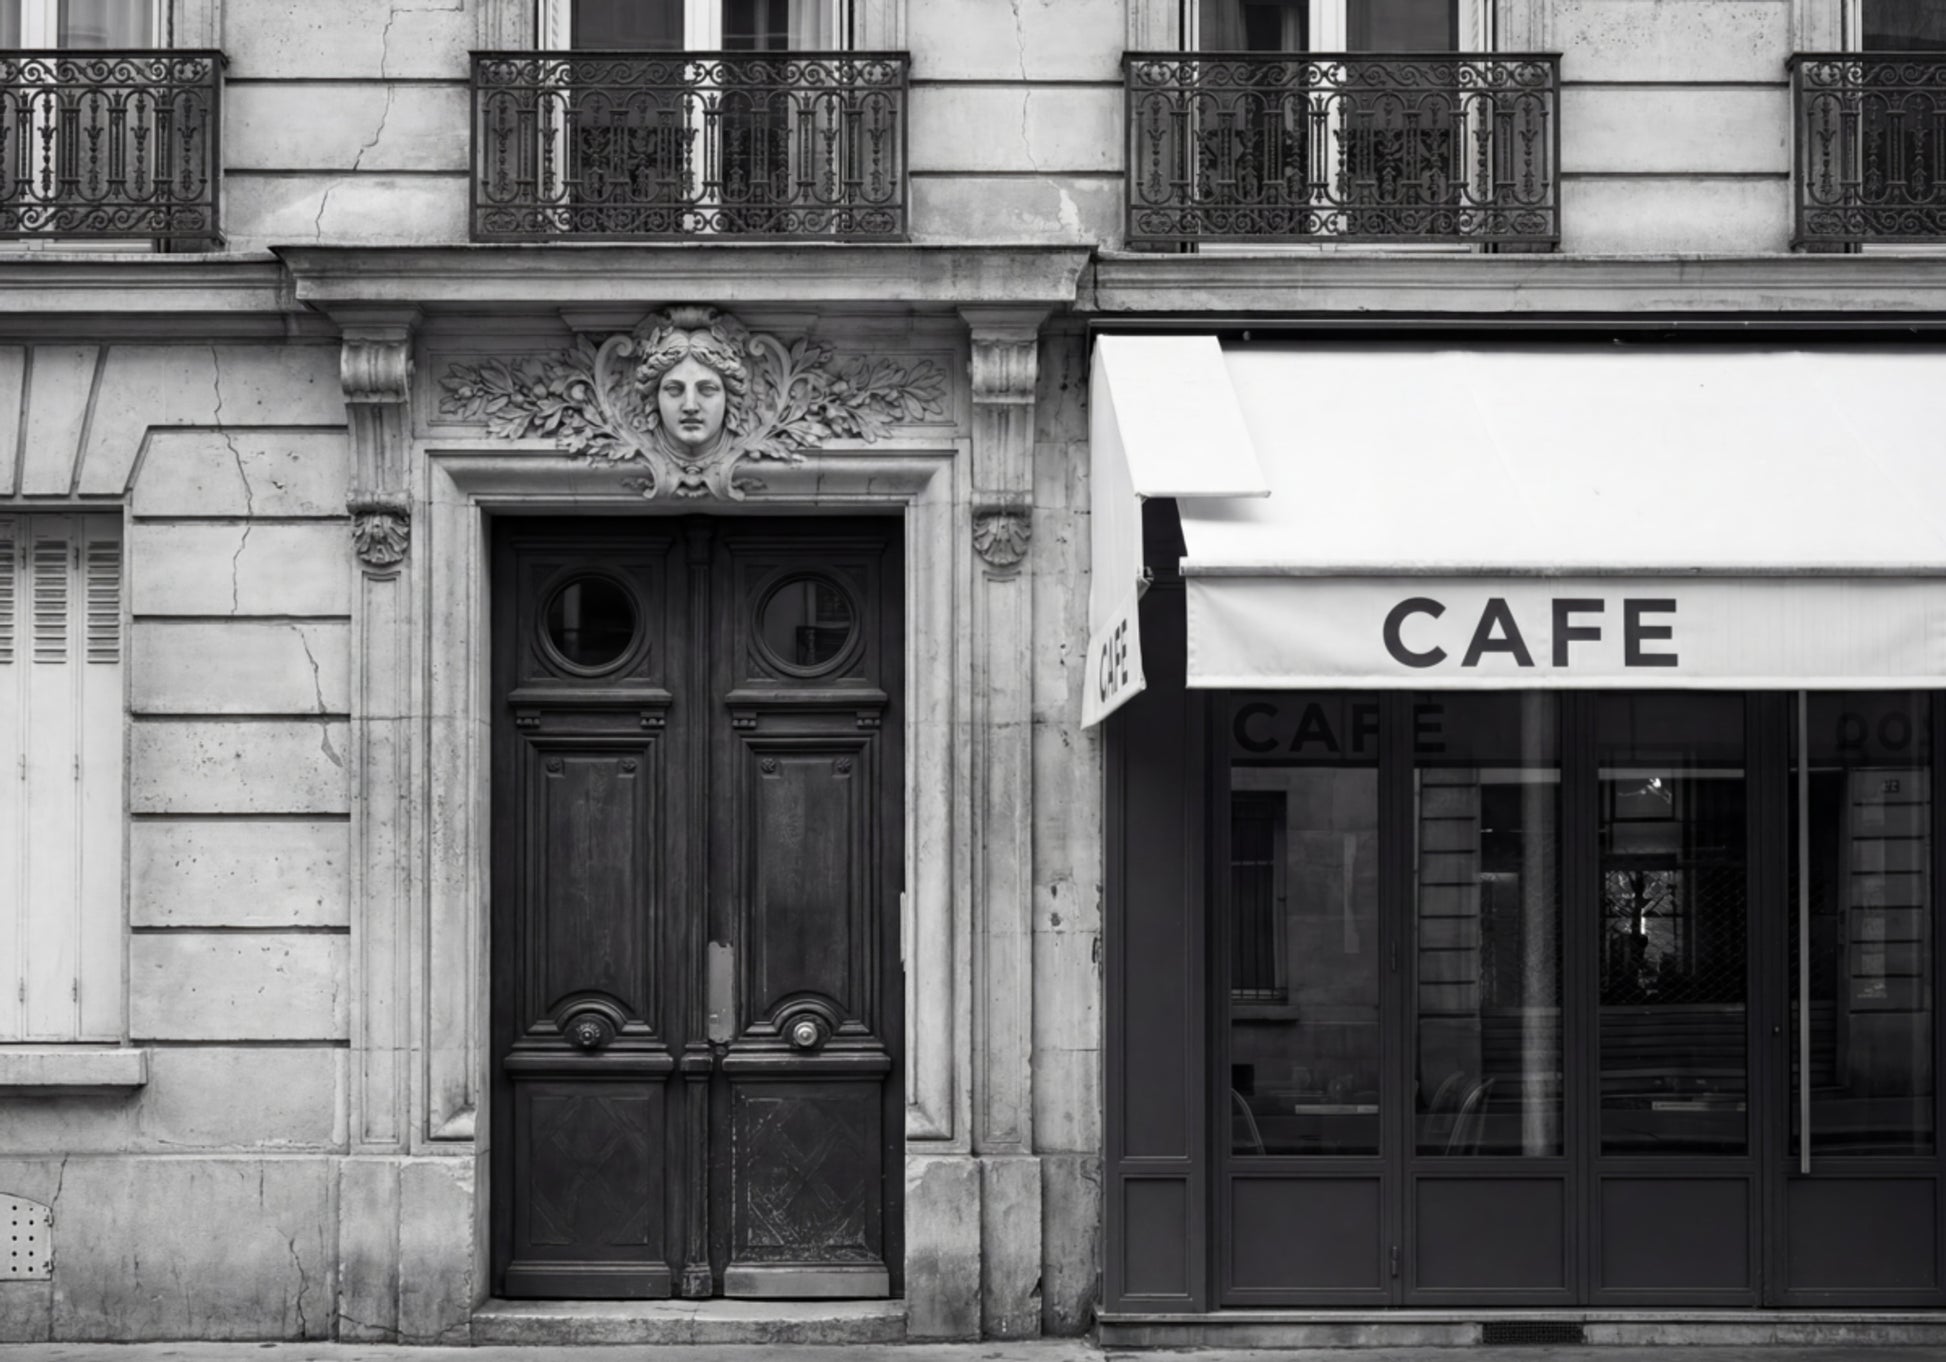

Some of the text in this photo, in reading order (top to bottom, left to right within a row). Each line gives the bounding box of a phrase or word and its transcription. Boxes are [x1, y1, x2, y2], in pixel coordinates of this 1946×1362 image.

[1099, 618, 1128, 703] CAFE
[1384, 597, 1678, 668] CAFE
[1233, 702, 1446, 753] CAFE
